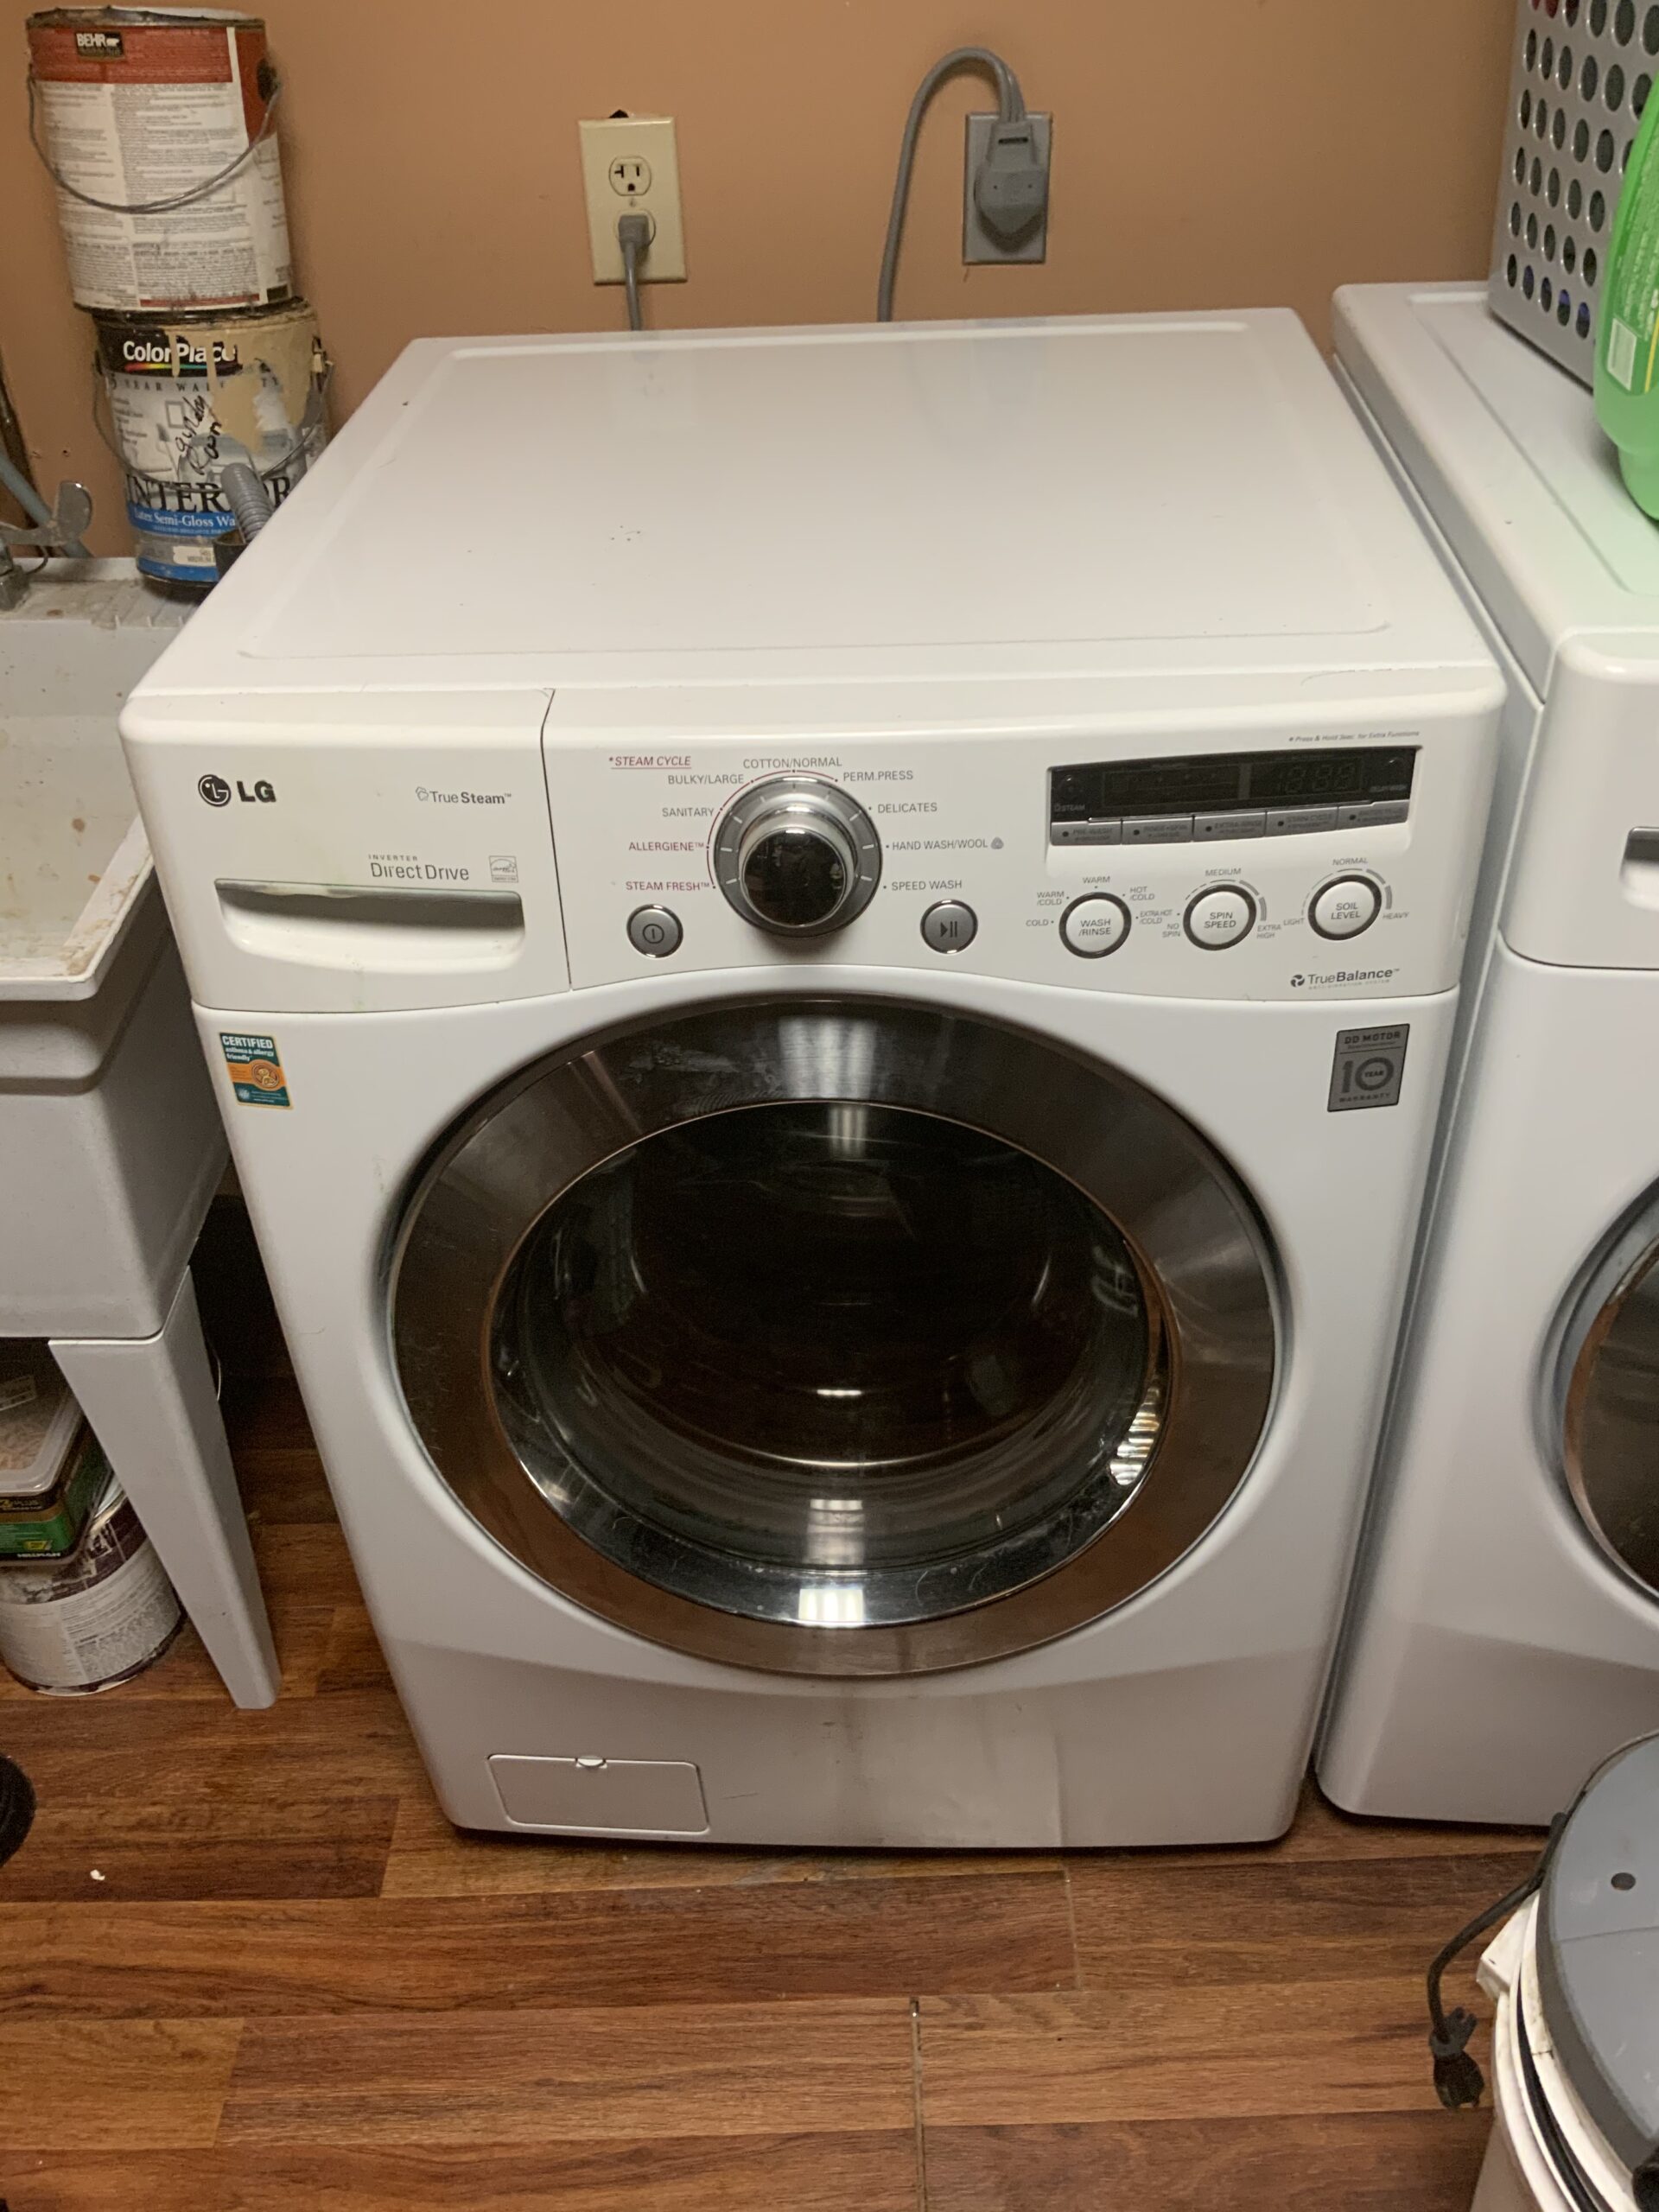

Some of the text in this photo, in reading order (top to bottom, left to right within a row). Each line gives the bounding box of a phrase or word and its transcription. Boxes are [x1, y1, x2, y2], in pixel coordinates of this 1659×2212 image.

[76, 33, 107, 47] BEHR
[124, 341, 172, 362] Color
[154, 511, 213, 527] Semi-Gloss
[216, 516, 235, 526] Wa
[657, 756, 690, 766] CYCLE
[743, 757, 842, 768] COTTON/NORMAL
[668, 774, 744, 785] BULKY/LARGE
[237, 780, 276, 803] LG
[662, 807, 714, 817] SANITARY
[878, 802, 938, 813] DELICATES
[893, 839, 988, 850] HAND WASH/WOOL
[371, 862, 469, 880] Direct Drive
[626, 881, 663, 891] STEAM
[892, 880, 962, 891] SPEED WASH
[1336, 902, 1358, 911] SOIL
[1331, 911, 1361, 920] LEVEL
[1080, 918, 1111, 927] WASH
[1203, 920, 1236, 929] SPEED
[1283, 918, 1305, 926] LIGHT
[1078, 928, 1111, 937] /RINSE
[1257, 924, 1281, 932] EXTRA
[222, 1035, 273, 1049] CERTIFIED
[1344, 1031, 1400, 1044] DD MOTOR
[1341, 1057, 1394, 1093] 10
